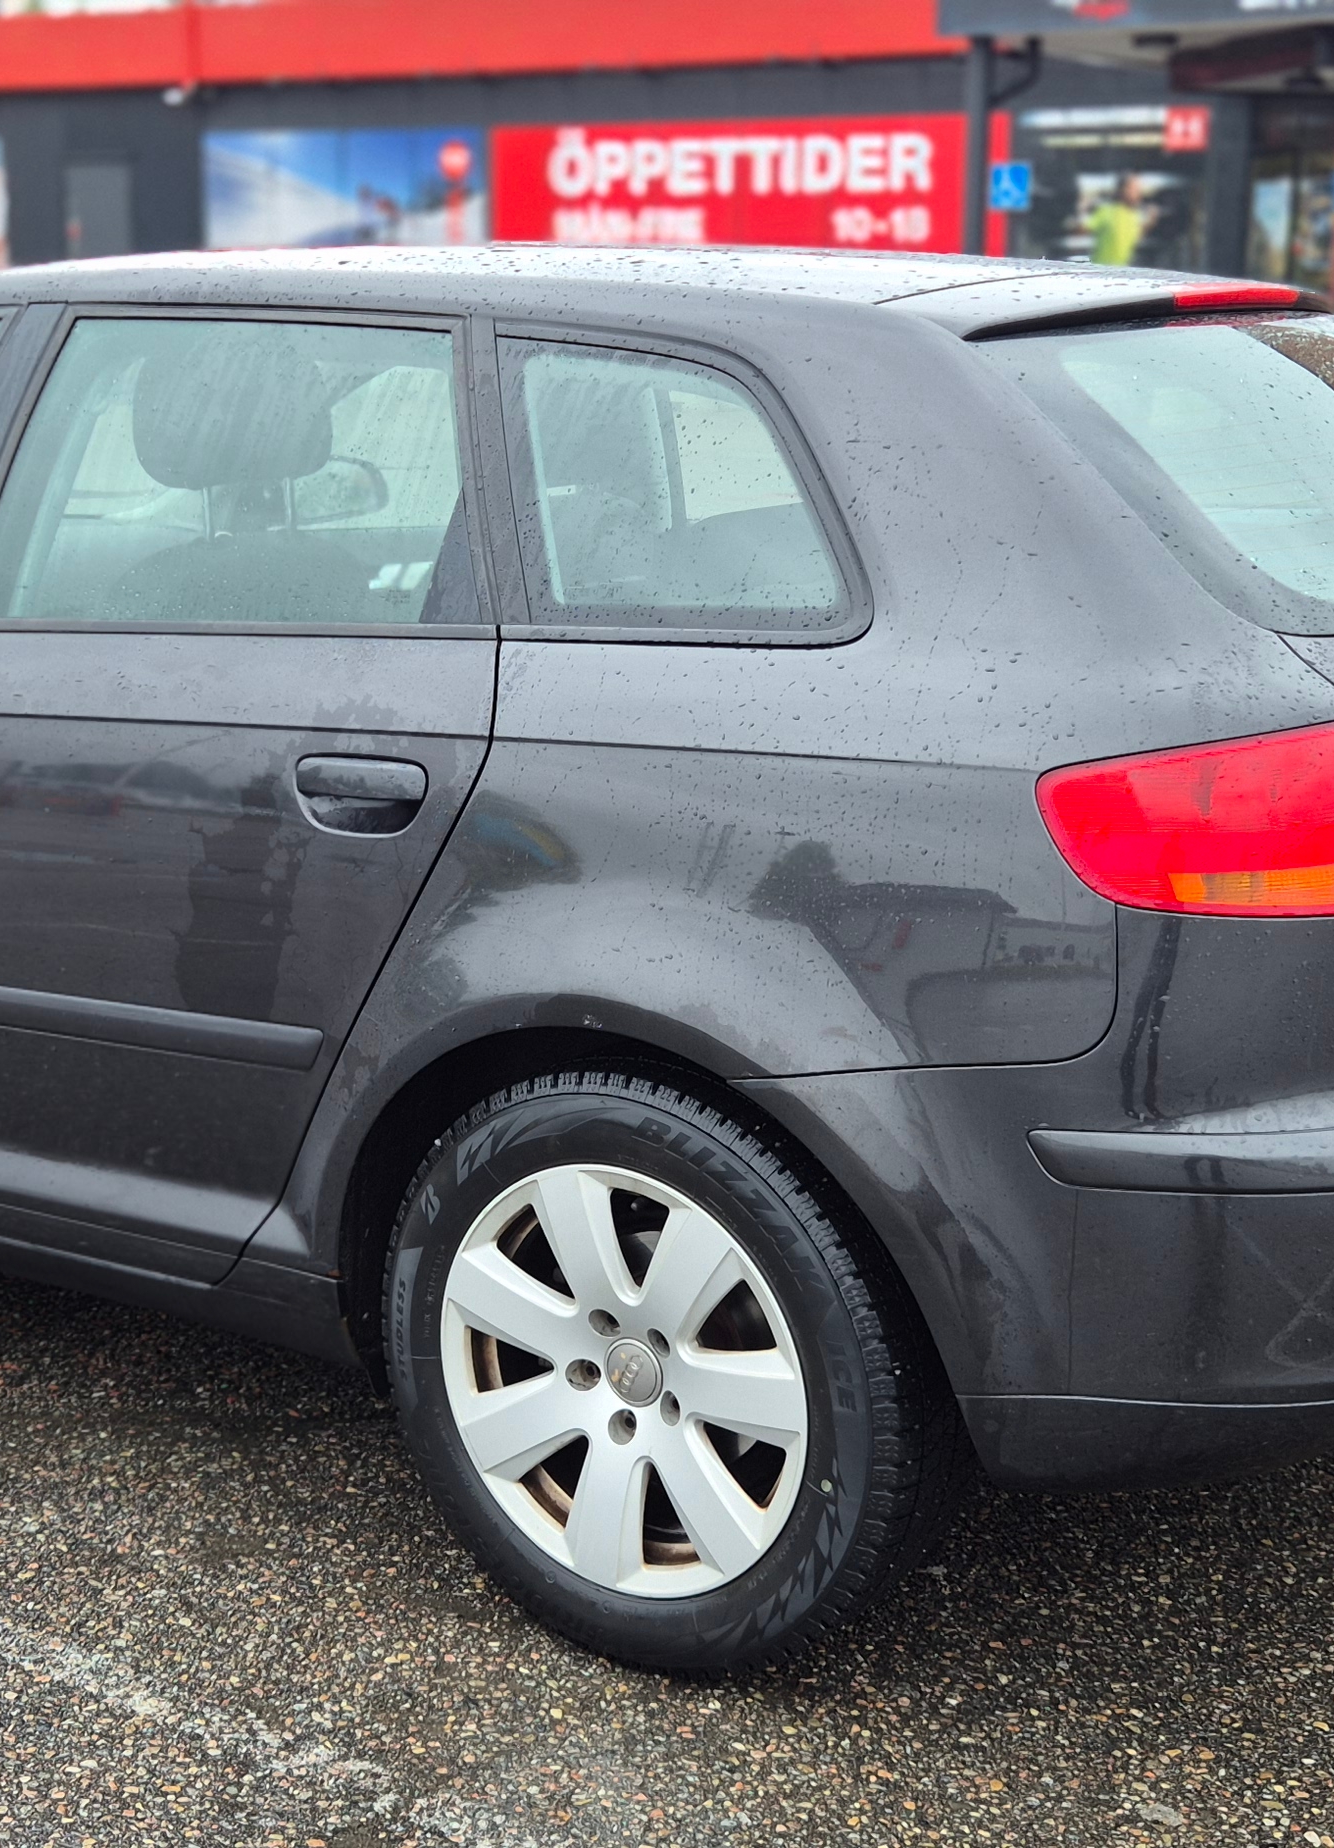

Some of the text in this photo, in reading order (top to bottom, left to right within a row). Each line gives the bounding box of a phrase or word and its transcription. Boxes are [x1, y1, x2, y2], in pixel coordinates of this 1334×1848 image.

[548, 126, 932, 197] ÖPPETTIDER
[631, 1116, 826, 1292] BLIZZAK
[394, 1277, 407, 1382] STUDLESS
[825, 1337, 858, 1413] ICE
